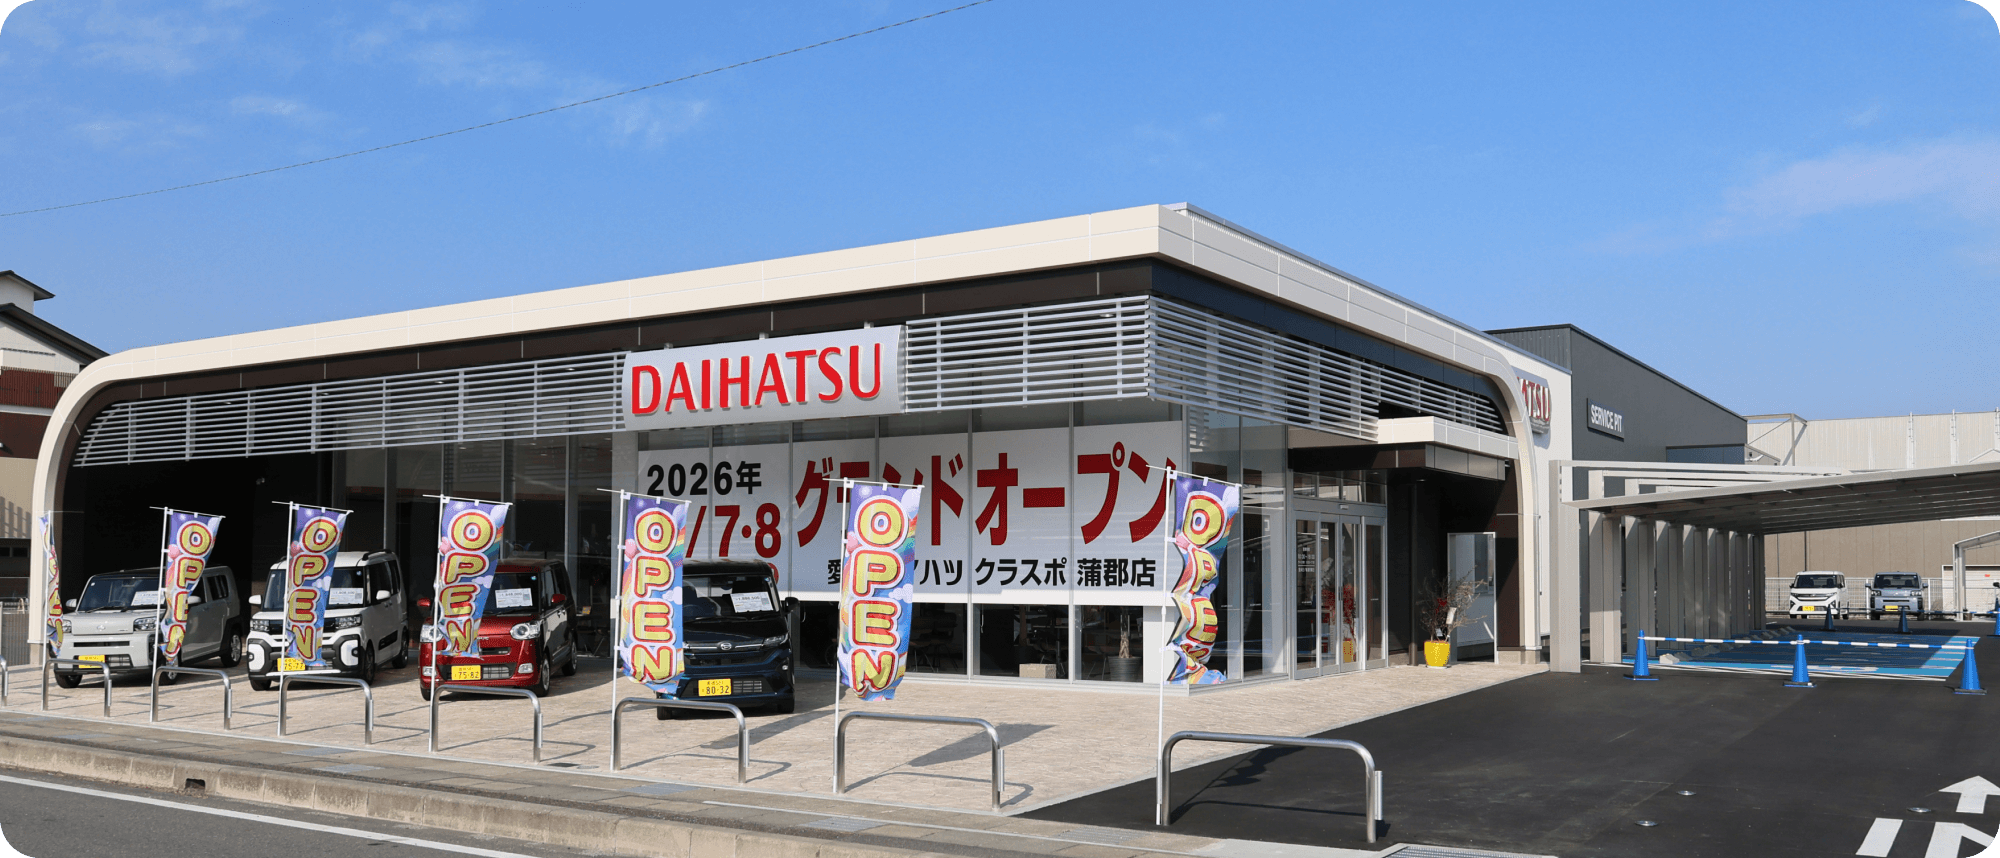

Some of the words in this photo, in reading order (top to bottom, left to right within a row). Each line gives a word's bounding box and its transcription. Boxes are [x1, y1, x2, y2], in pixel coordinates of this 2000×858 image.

[631, 343, 882, 415] DAIHATSU
[1517, 376, 1550, 422] ATSU
[1591, 404, 1613, 430] SERVICE
[1614, 412, 1622, 432] PIT
[647, 461, 762, 497] 2026年
[288, 519, 340, 661] OPEN
[438, 510, 494, 653] OPEN
[631, 509, 676, 682] OPEN
[852, 497, 907, 694] OPEN
[974, 557, 1068, 586] クラスポ
[1076, 558, 1157, 587] 蒲郡店
